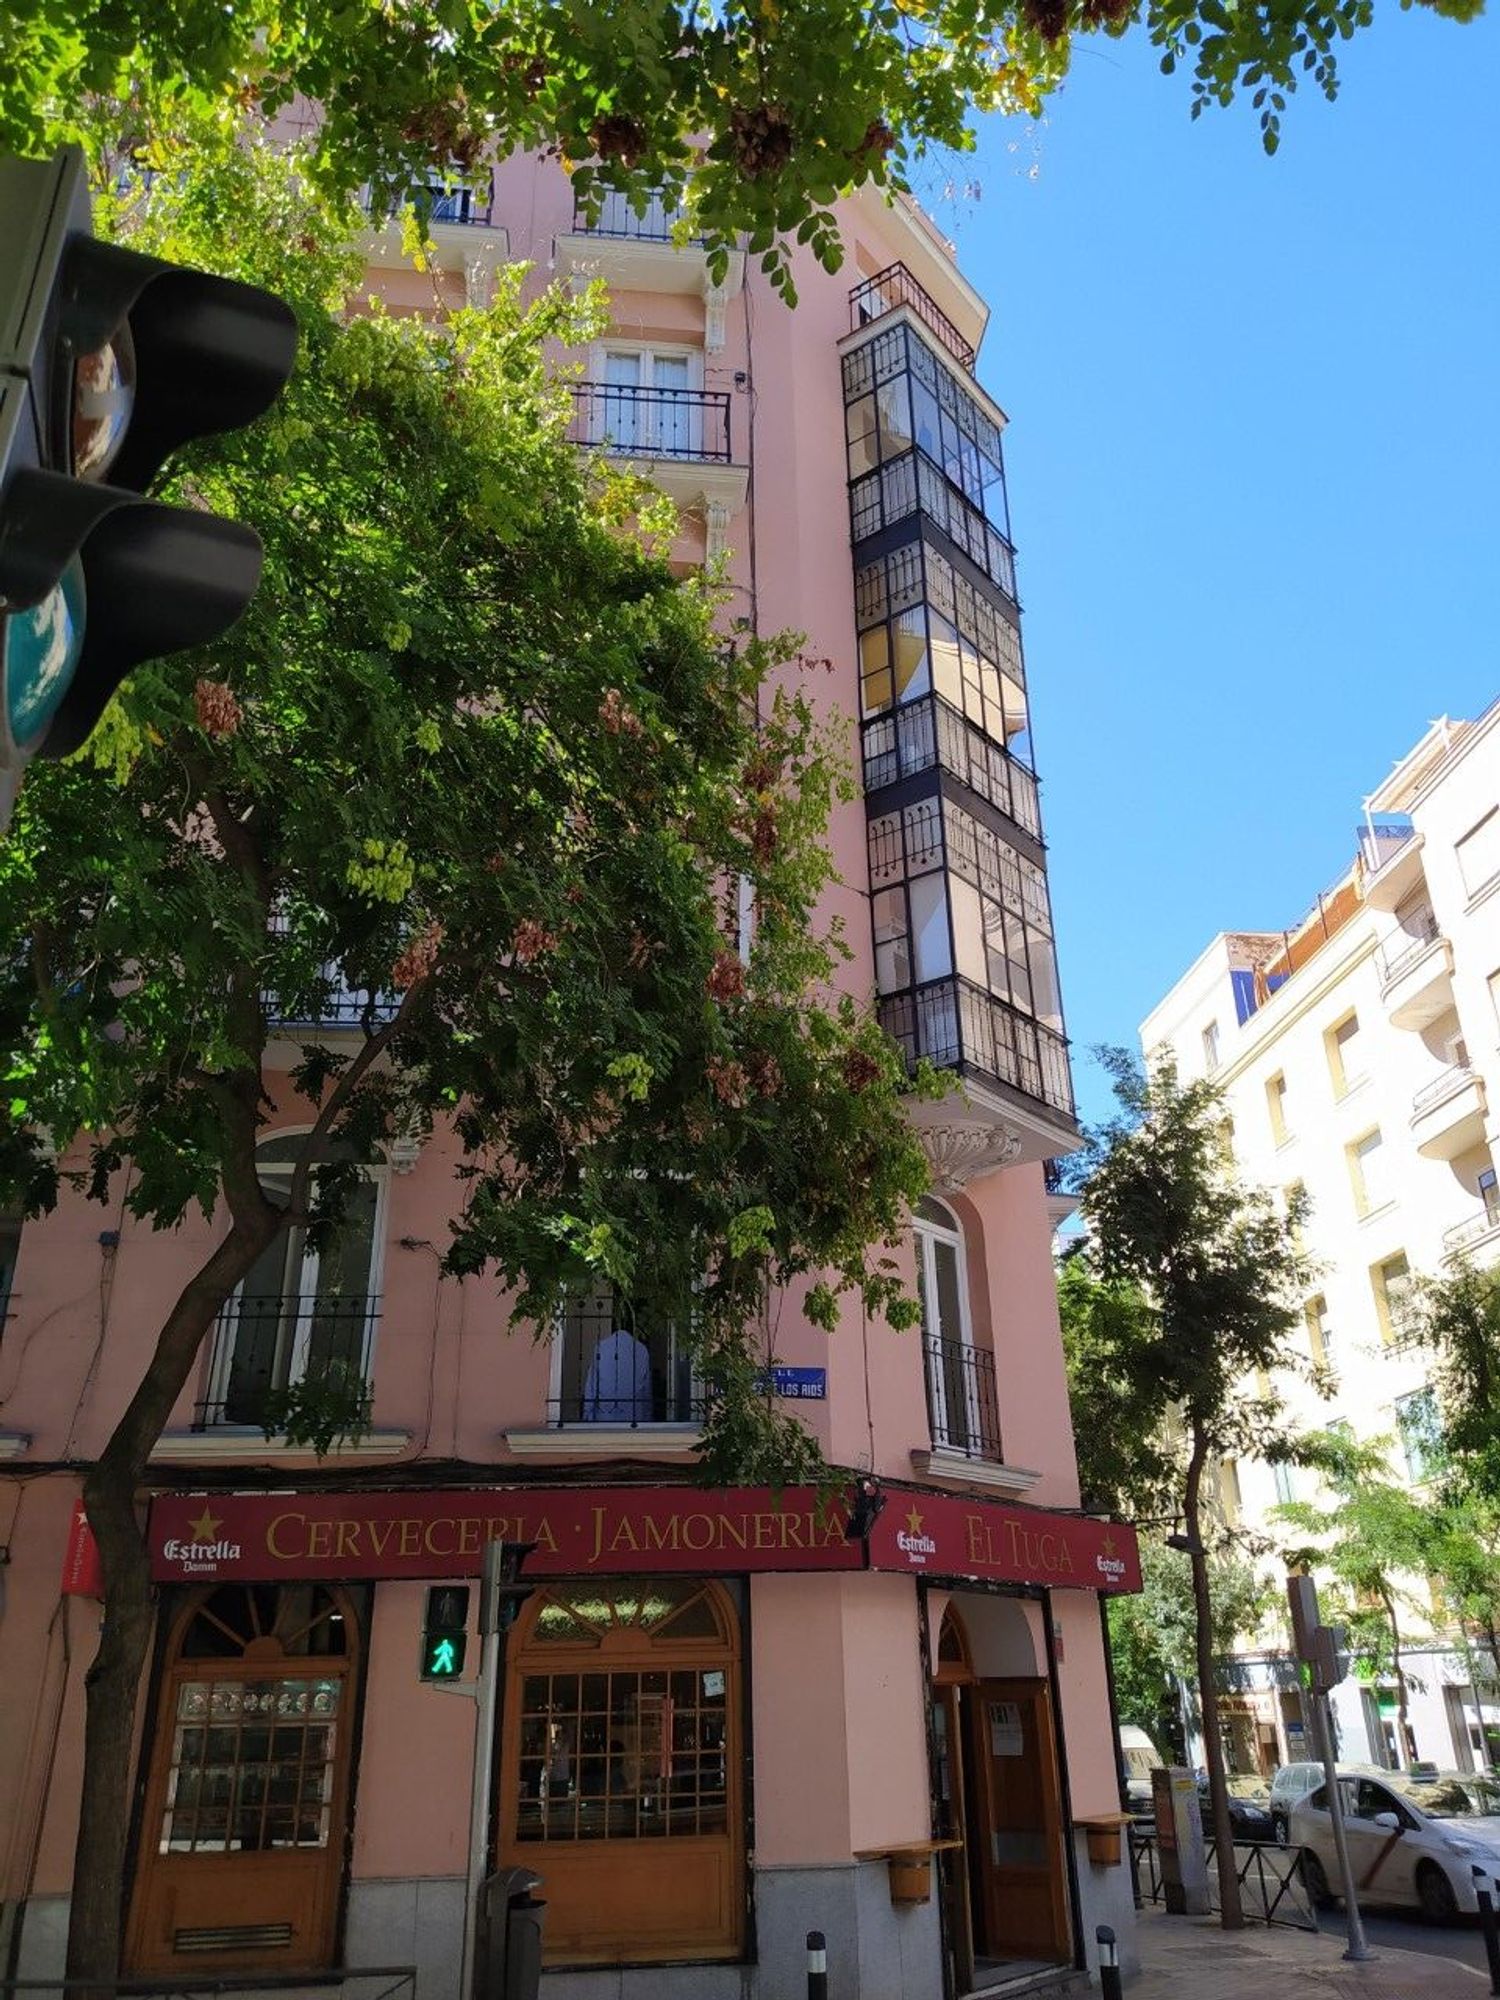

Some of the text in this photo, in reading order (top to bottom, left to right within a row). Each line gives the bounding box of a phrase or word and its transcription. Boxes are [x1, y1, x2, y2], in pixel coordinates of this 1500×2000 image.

[781, 1383, 798, 1396] LOS
[266, 1507, 851, 1563] CERVECERIA JAMONERIA
[897, 1530, 936, 1553] Estrella
[966, 1515, 1074, 1574] EL TUGA
[163, 1539, 241, 1560] Estrella
[183, 1561, 217, 1573] Damm
